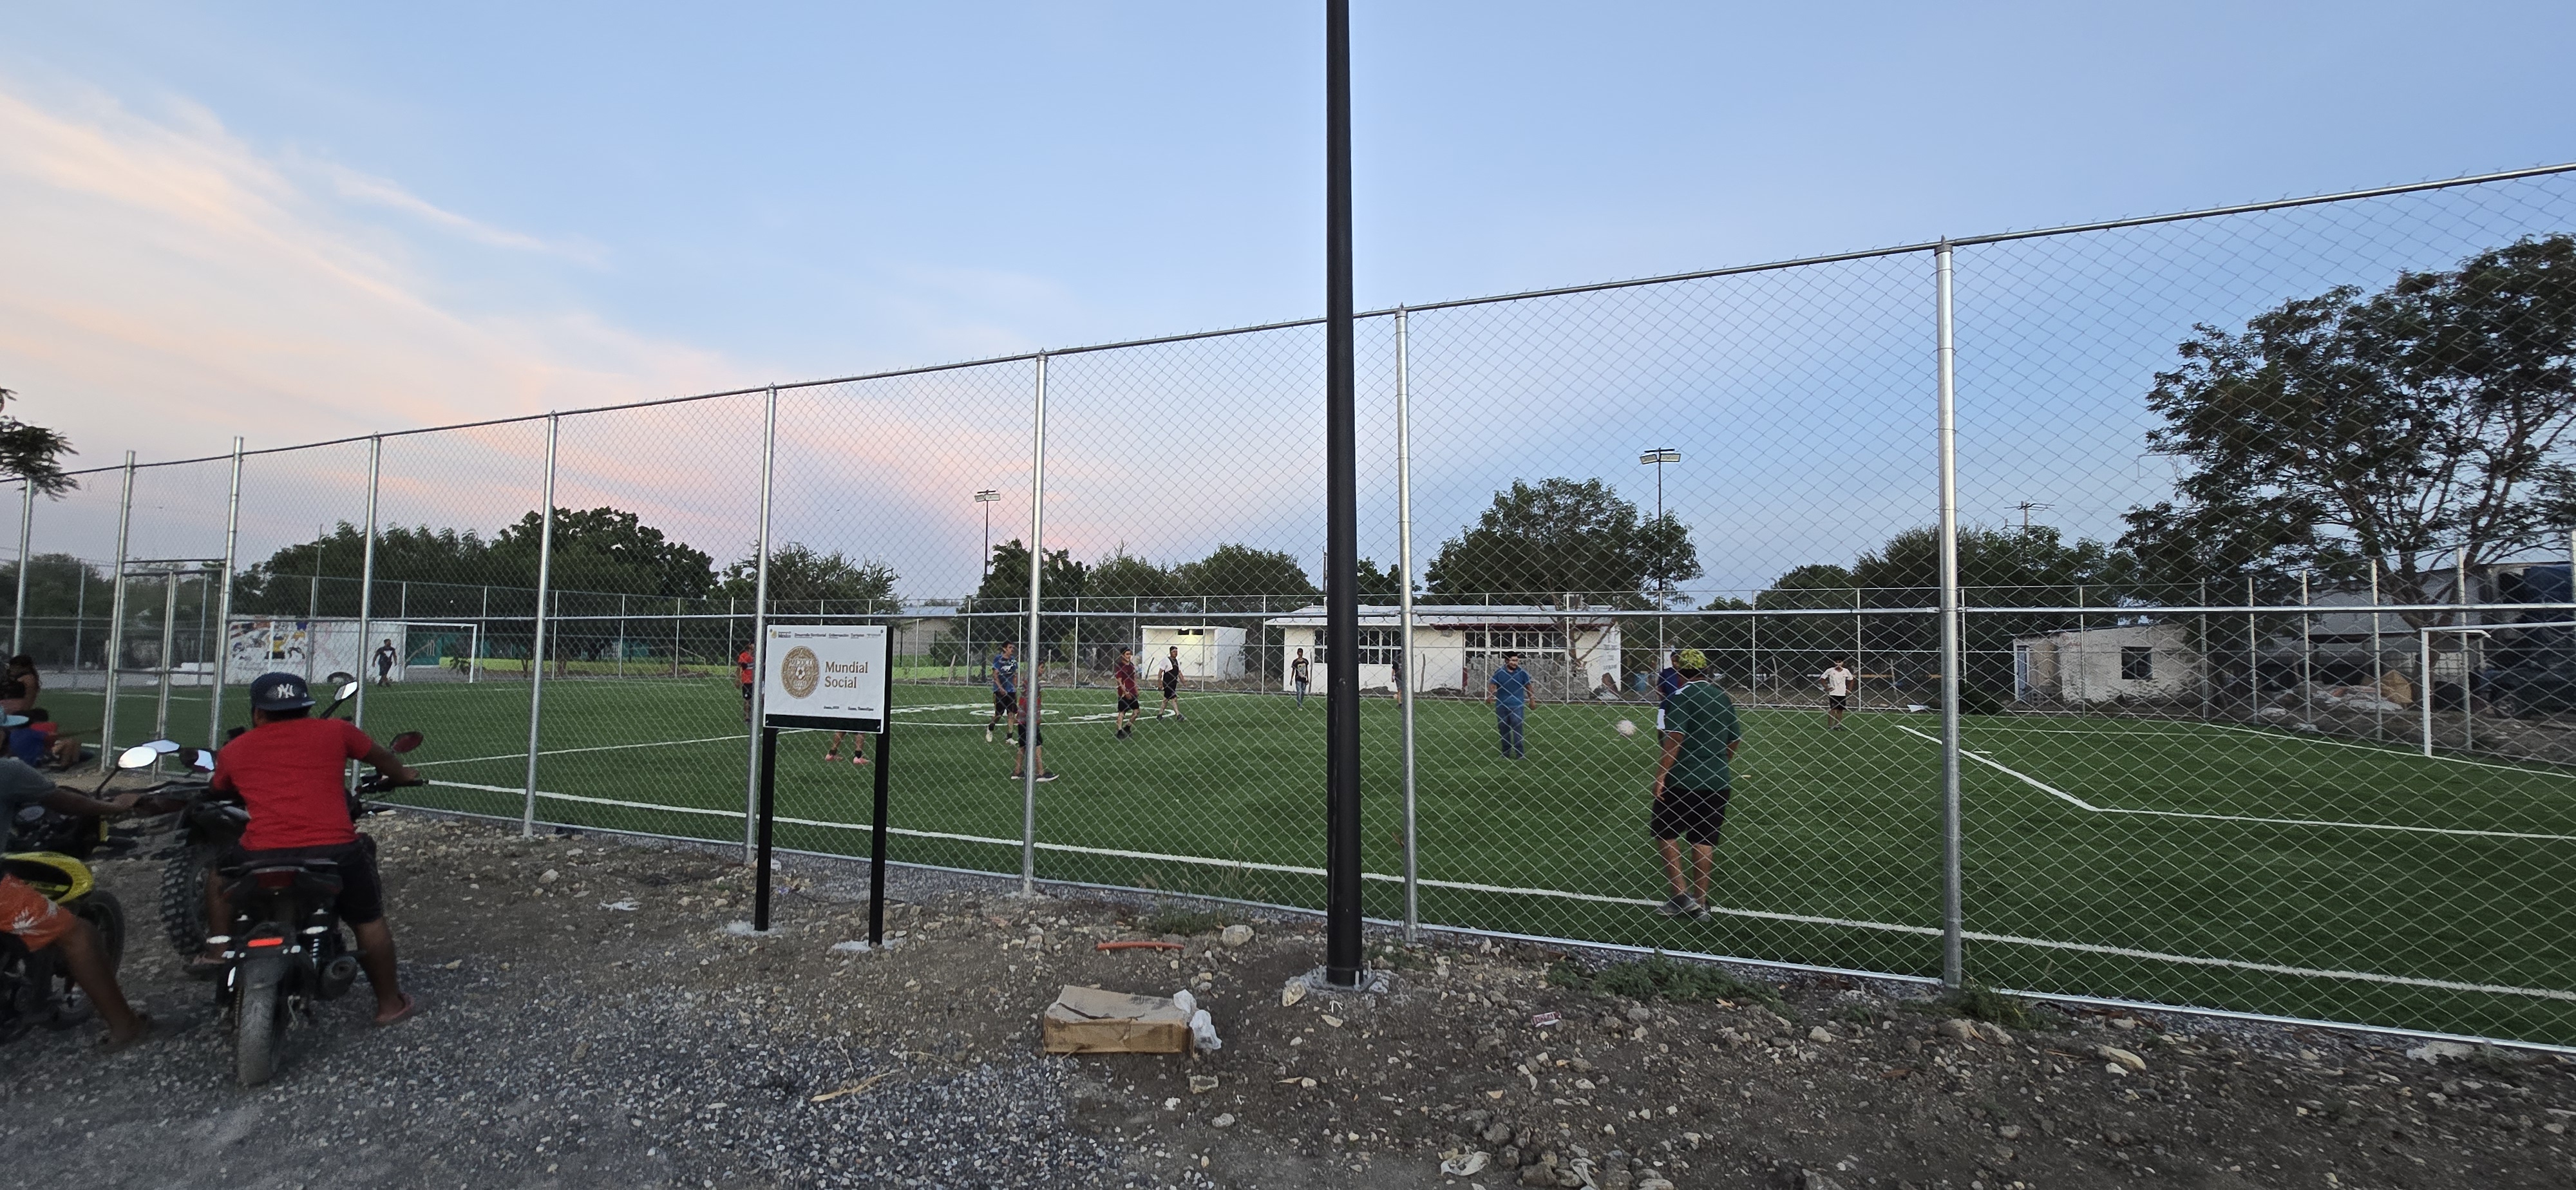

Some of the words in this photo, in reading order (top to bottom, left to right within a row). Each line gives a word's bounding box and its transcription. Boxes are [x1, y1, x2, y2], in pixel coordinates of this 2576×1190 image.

[825, 661, 868, 674] Mundial
[824, 675, 857, 688] Social
[277, 683, 295, 699] NY
